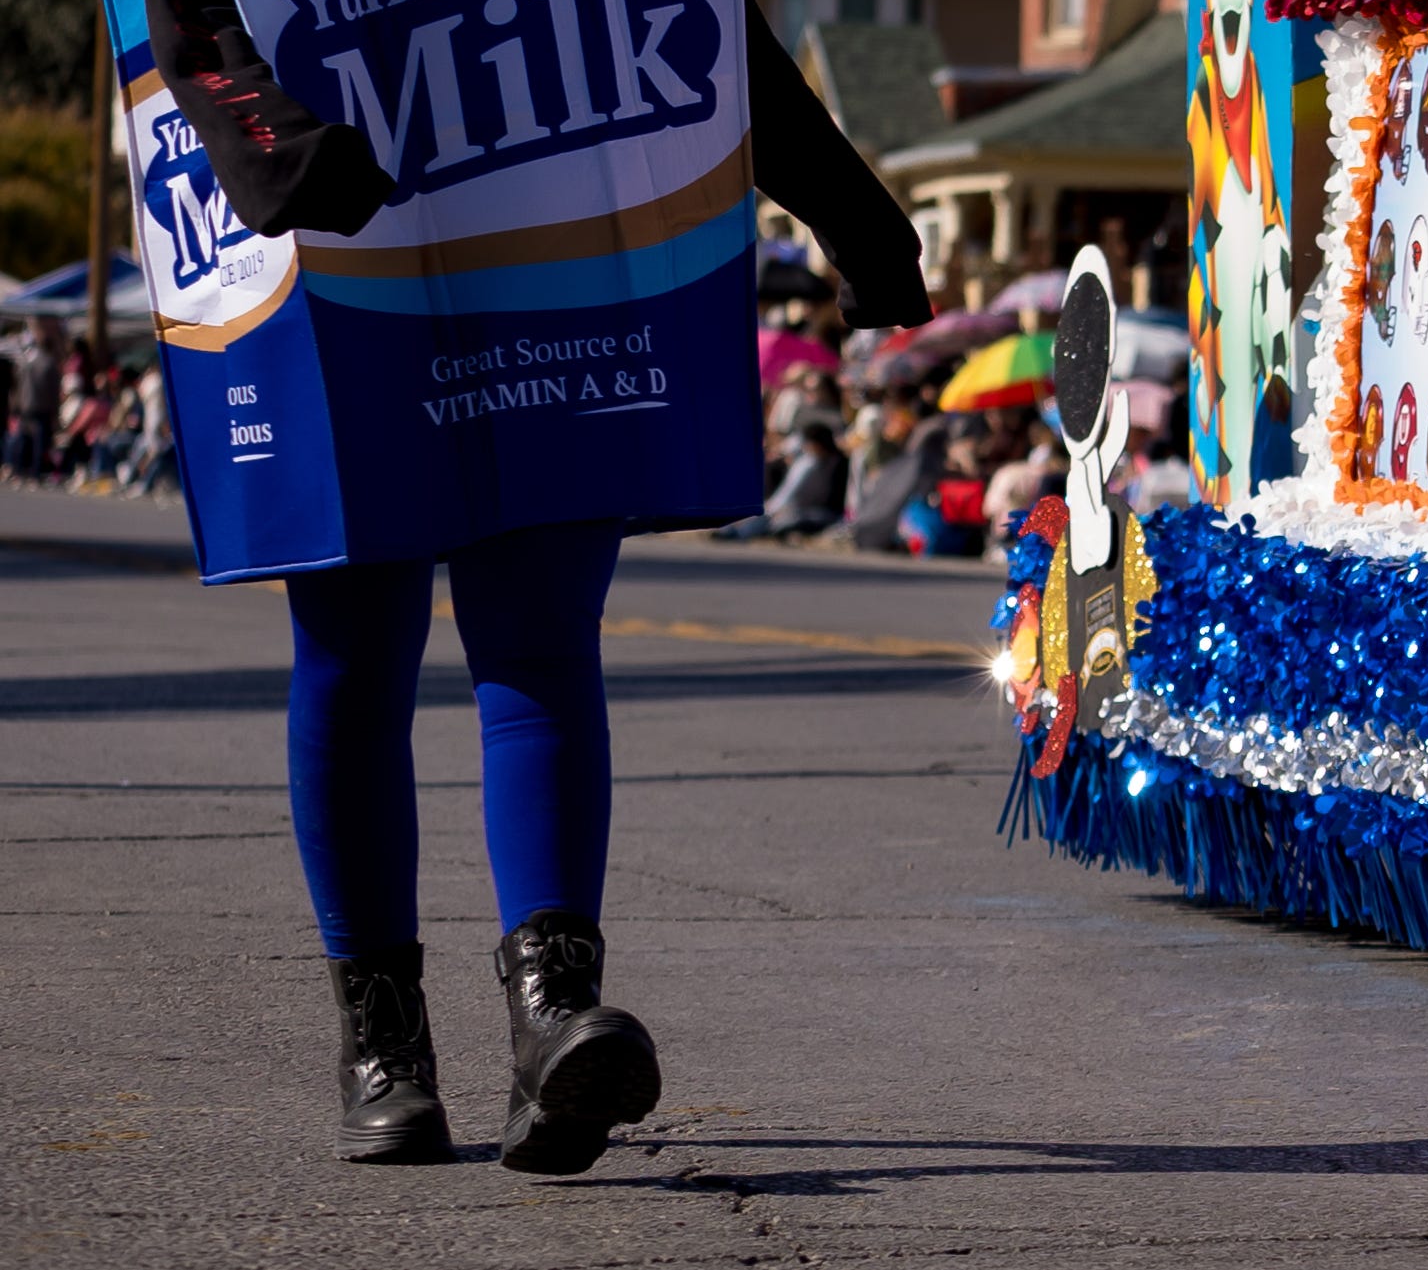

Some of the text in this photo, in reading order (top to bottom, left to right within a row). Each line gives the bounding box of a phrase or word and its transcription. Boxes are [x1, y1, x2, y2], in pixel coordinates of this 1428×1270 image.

[239, 249, 265, 280] 2019
[431, 325, 652, 382] Great Source of
[421, 367, 667, 426] VITAMIN A & D
